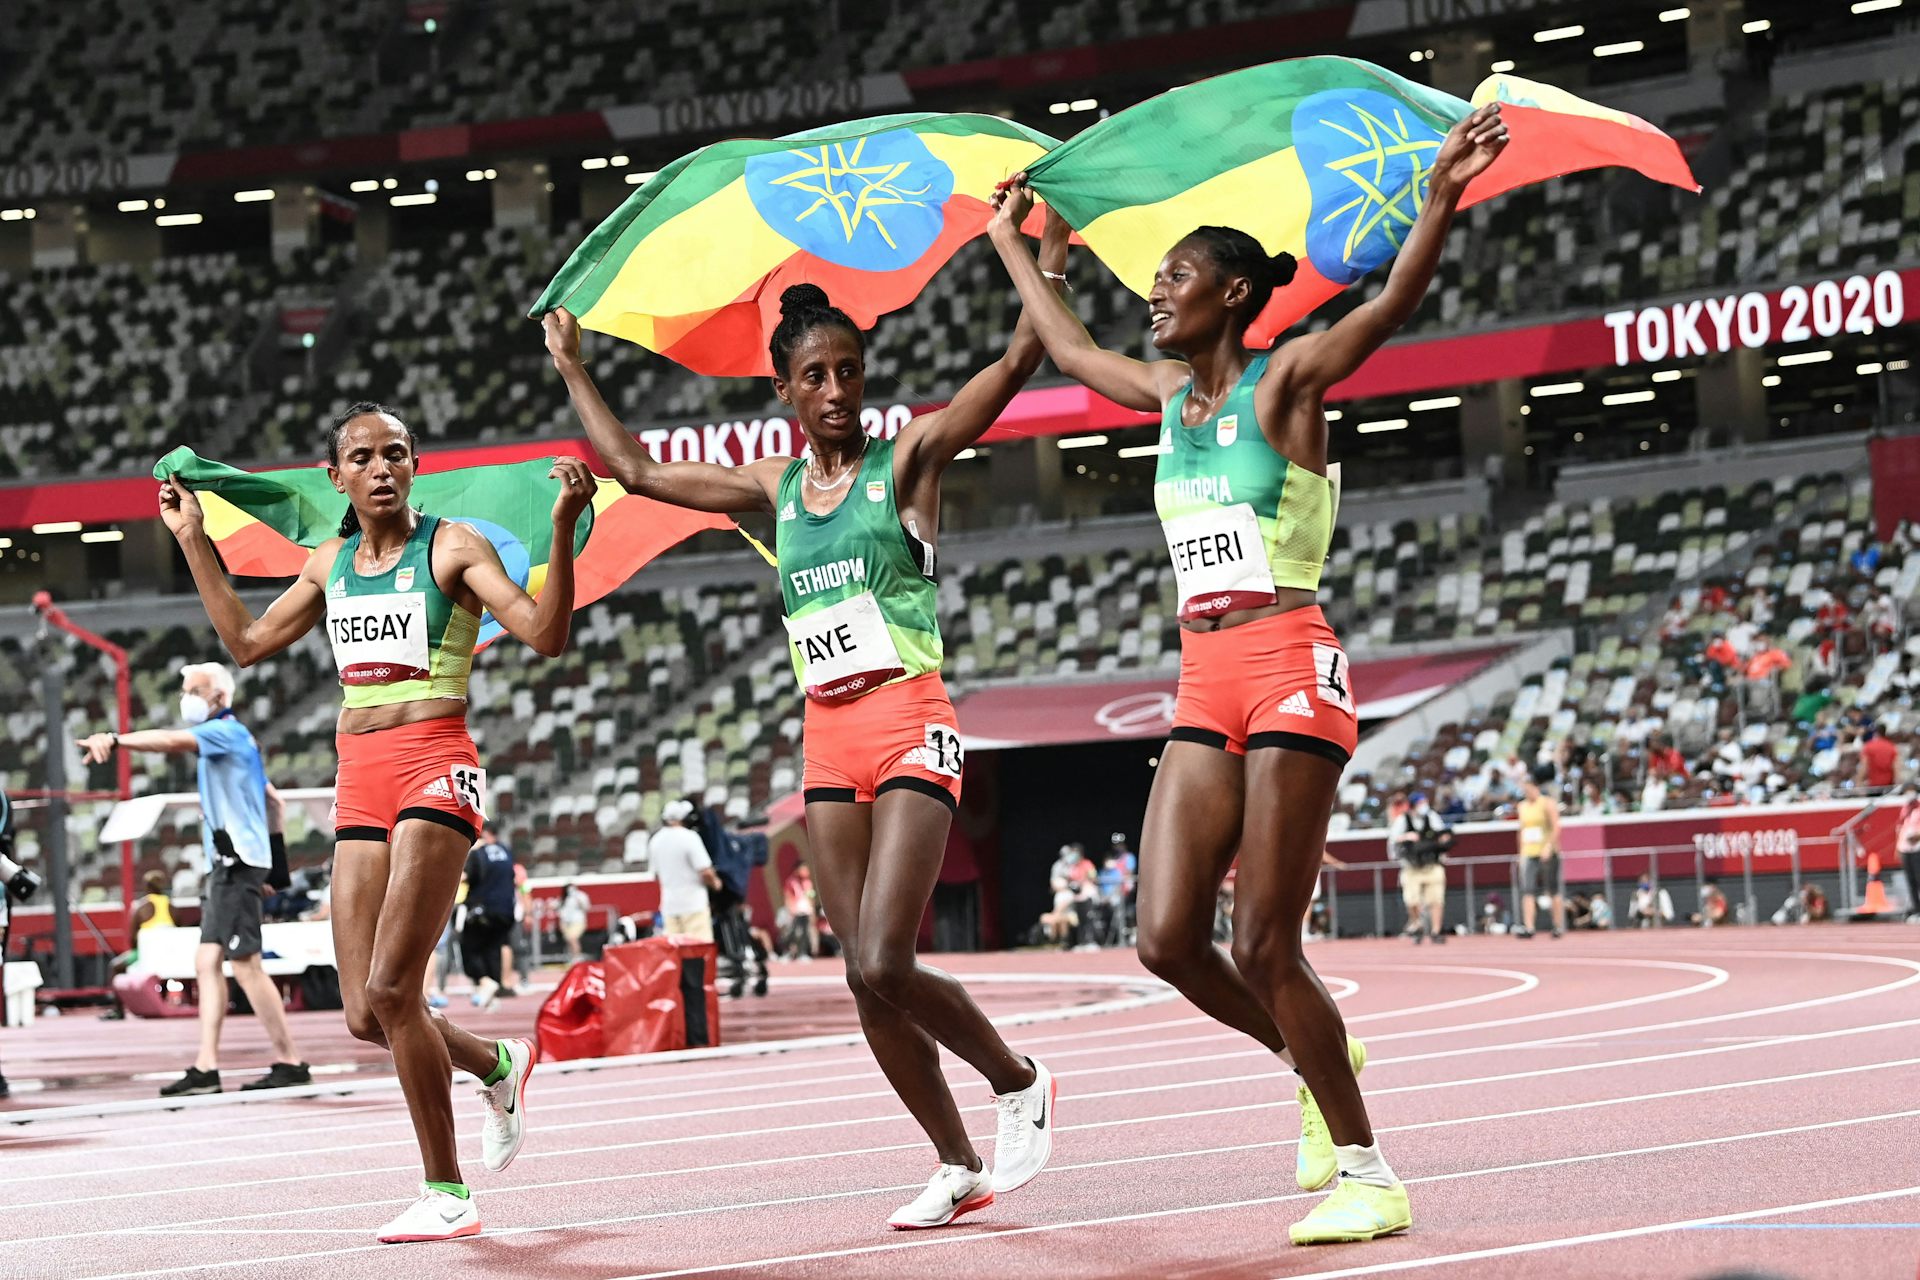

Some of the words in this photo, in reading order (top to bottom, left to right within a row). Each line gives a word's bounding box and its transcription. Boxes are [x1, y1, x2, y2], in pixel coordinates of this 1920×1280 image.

[1604, 291, 1771, 367] TOKYO
[1779, 269, 1905, 343] 2020
[639, 416, 793, 467] TOKYO
[331, 612, 412, 644] TSEGAY
[1328, 652, 1347, 702] 4
[1277, 704, 1315, 718] adidas
[931, 730, 963, 776] 13
[423, 787, 453, 800] adidas
[455, 769, 481, 810] 15
[1692, 830, 1752, 859] TOKYO
